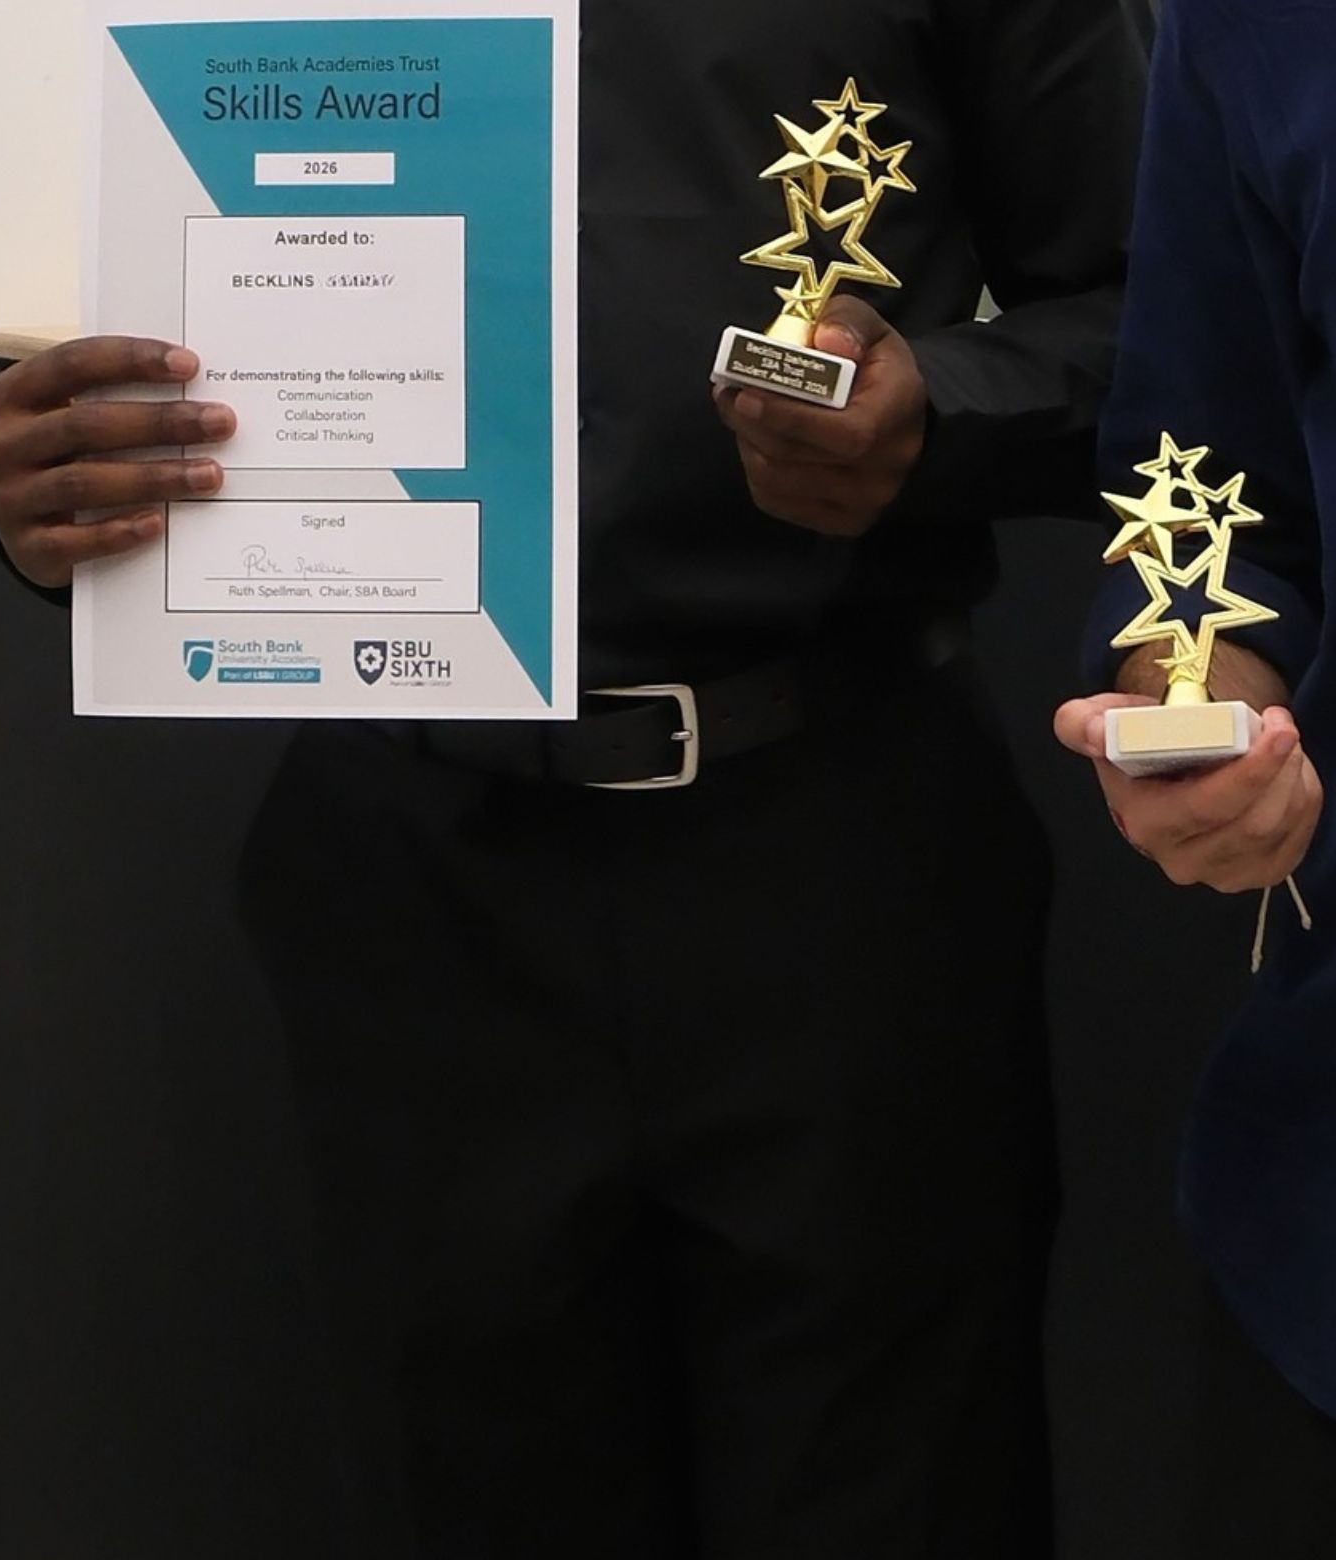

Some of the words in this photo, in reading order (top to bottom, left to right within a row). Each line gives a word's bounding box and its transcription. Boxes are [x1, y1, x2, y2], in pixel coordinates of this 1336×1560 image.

[205, 58, 252, 74] South
[257, 57, 298, 73] Bank
[303, 55, 394, 72] Academies
[398, 55, 440, 72] Trust
[203, 83, 302, 121] Skills
[315, 81, 440, 120] Award
[303, 161, 338, 174] 2026
[274, 230, 348, 245] Awarded
[353, 231, 375, 245] to:
[232, 274, 315, 288] BECKLINS
[206, 369, 227, 381] For
[230, 369, 321, 383] demonstrating
[324, 369, 345, 381] the
[348, 369, 406, 384] following
[276, 389, 374, 401] Communication
[284, 409, 366, 422] Collaboration
[276, 429, 319, 441] Critical
[322, 429, 374, 444] Thinking
[301, 515, 346, 530] Signed
[228, 585, 254, 597] Ruth
[355, 586, 379, 597] SBA
[382, 585, 417, 598] Board
[218, 640, 262, 653] South
[266, 640, 304, 653] Bank
[391, 641, 431, 658] SBU
[390, 660, 450, 678] SIXTH
